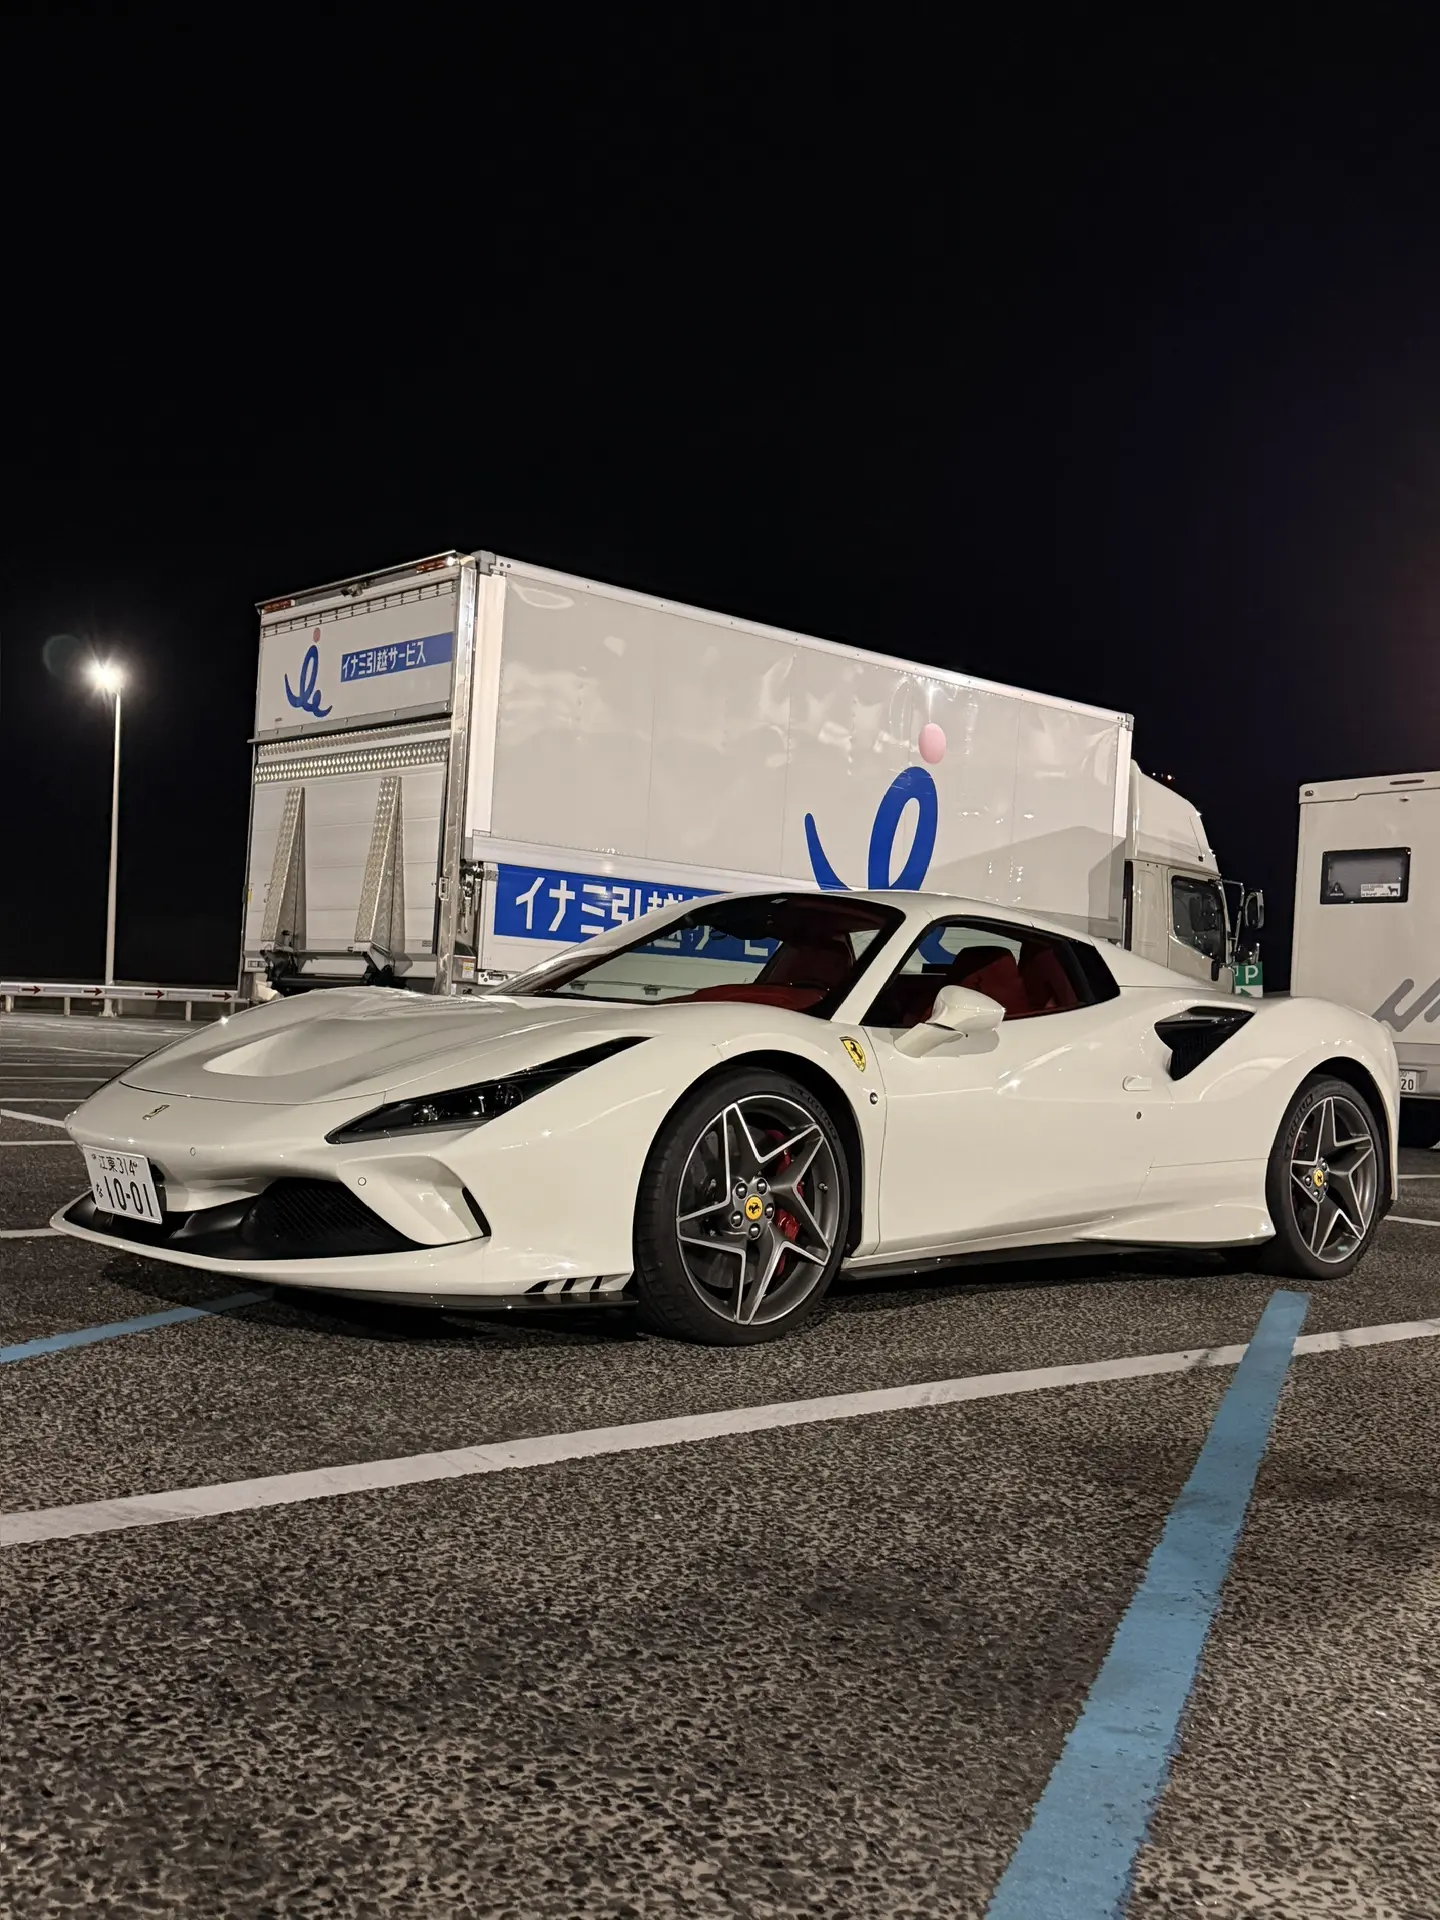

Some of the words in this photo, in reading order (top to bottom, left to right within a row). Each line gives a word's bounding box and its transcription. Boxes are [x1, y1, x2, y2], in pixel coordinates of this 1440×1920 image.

[341, 641, 427, 679] イナミ引越サービス
[1244, 964, 1259, 985] P
[103, 1175, 154, 1217] 10-01
